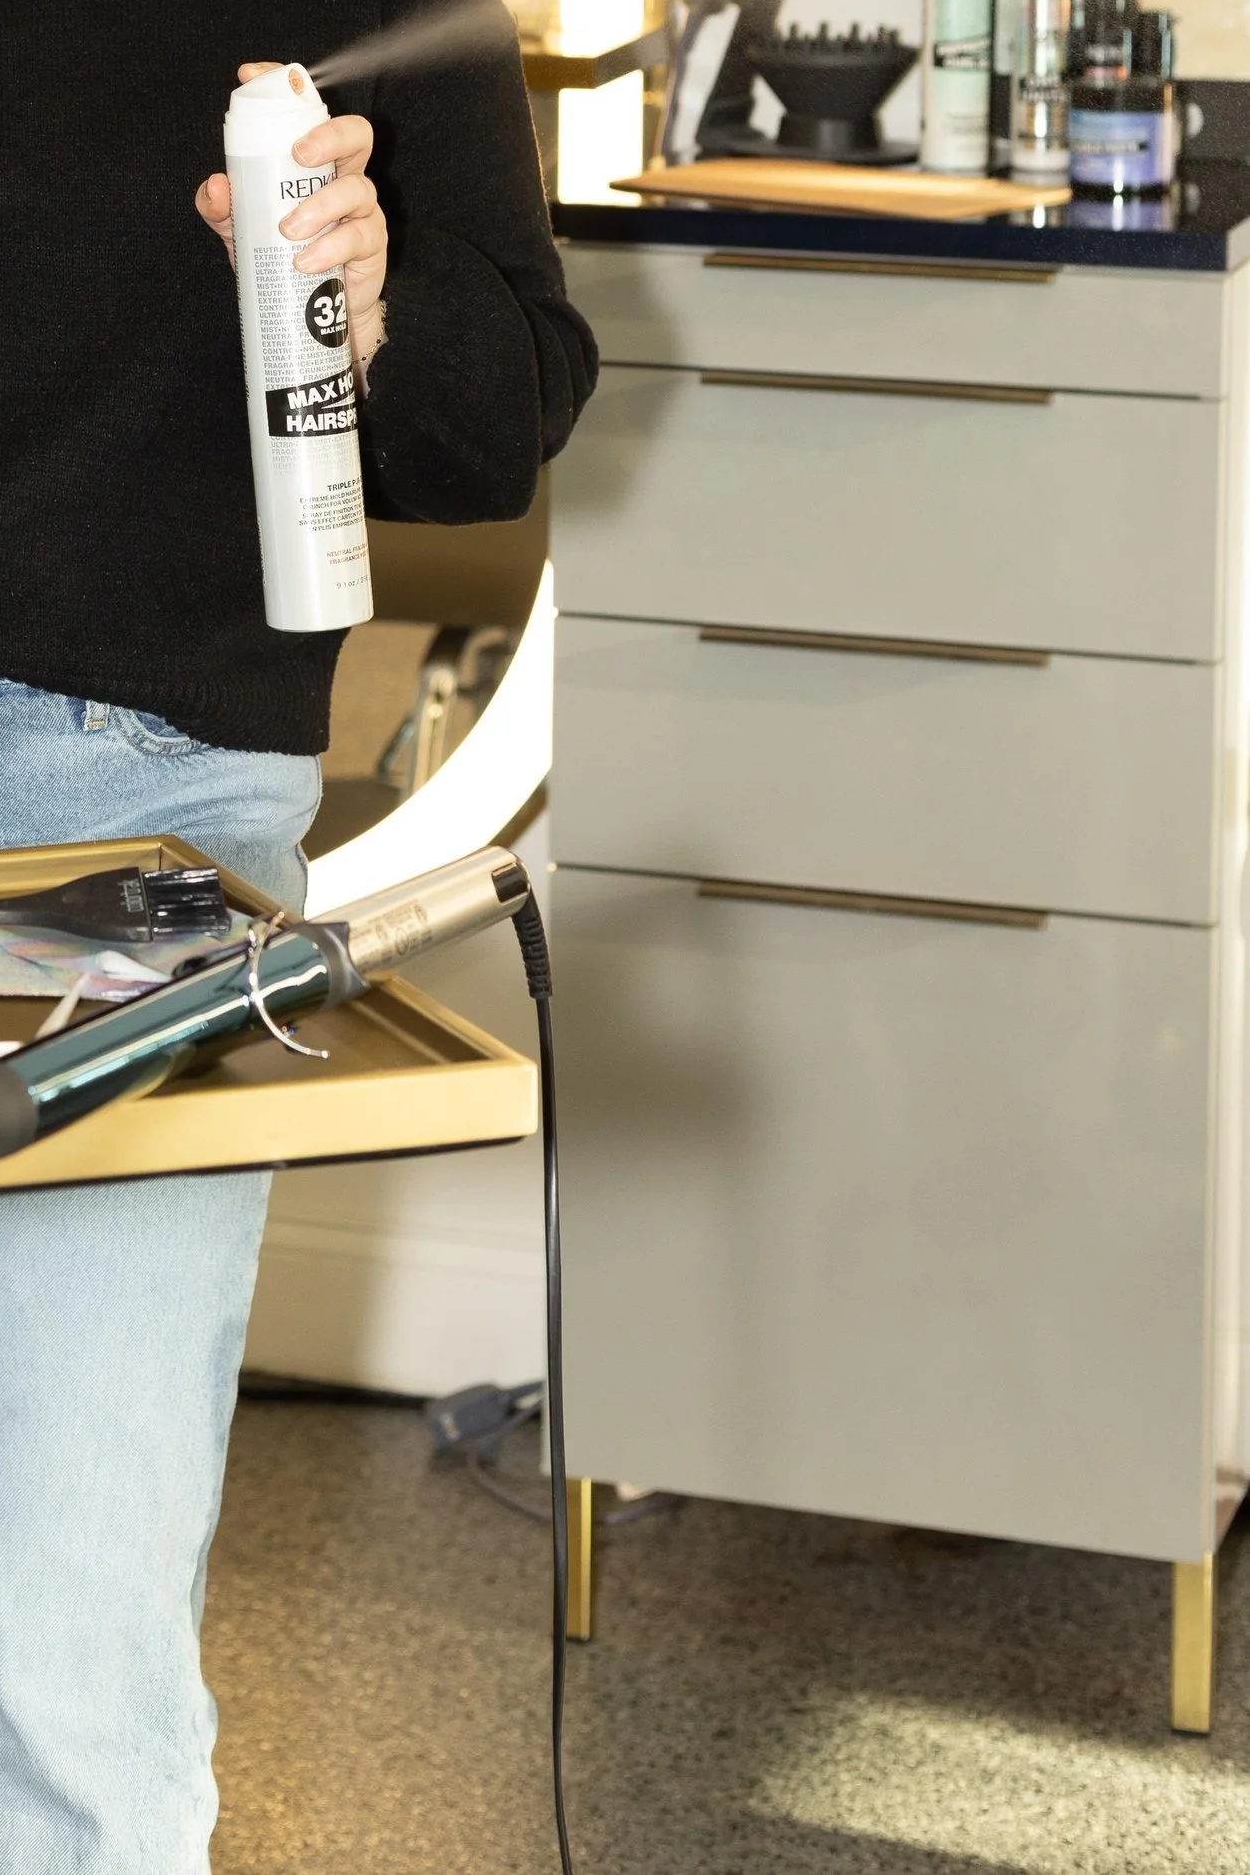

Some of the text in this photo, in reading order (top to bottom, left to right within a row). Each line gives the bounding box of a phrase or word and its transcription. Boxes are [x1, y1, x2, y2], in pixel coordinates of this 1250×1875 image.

[280, 172, 338, 200] REDK
[313, 292, 347, 327] 32
[320, 327, 336, 335] MAX
[287, 371, 354, 410] MAX HO
[327, 480, 352, 492] TRIPLE
